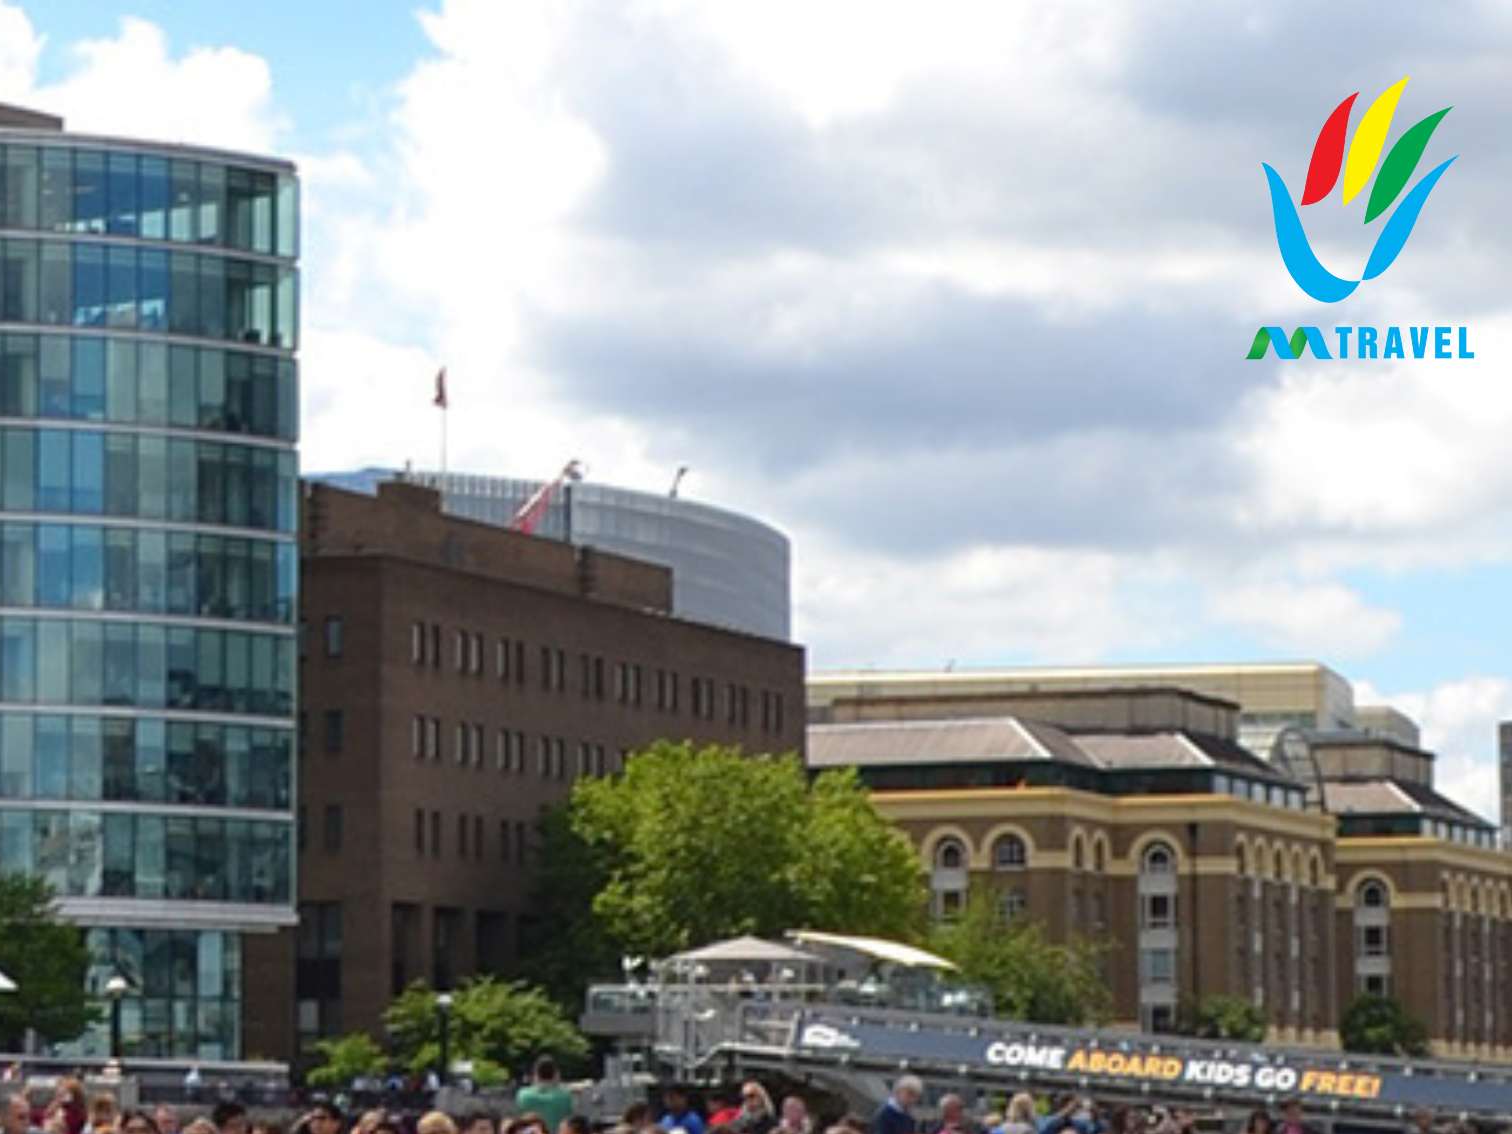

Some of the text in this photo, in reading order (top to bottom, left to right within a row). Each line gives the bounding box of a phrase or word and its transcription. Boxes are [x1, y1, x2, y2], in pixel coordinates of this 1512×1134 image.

[986, 1041, 1382, 1098] COME ABOARD KIDS GO FREE!
